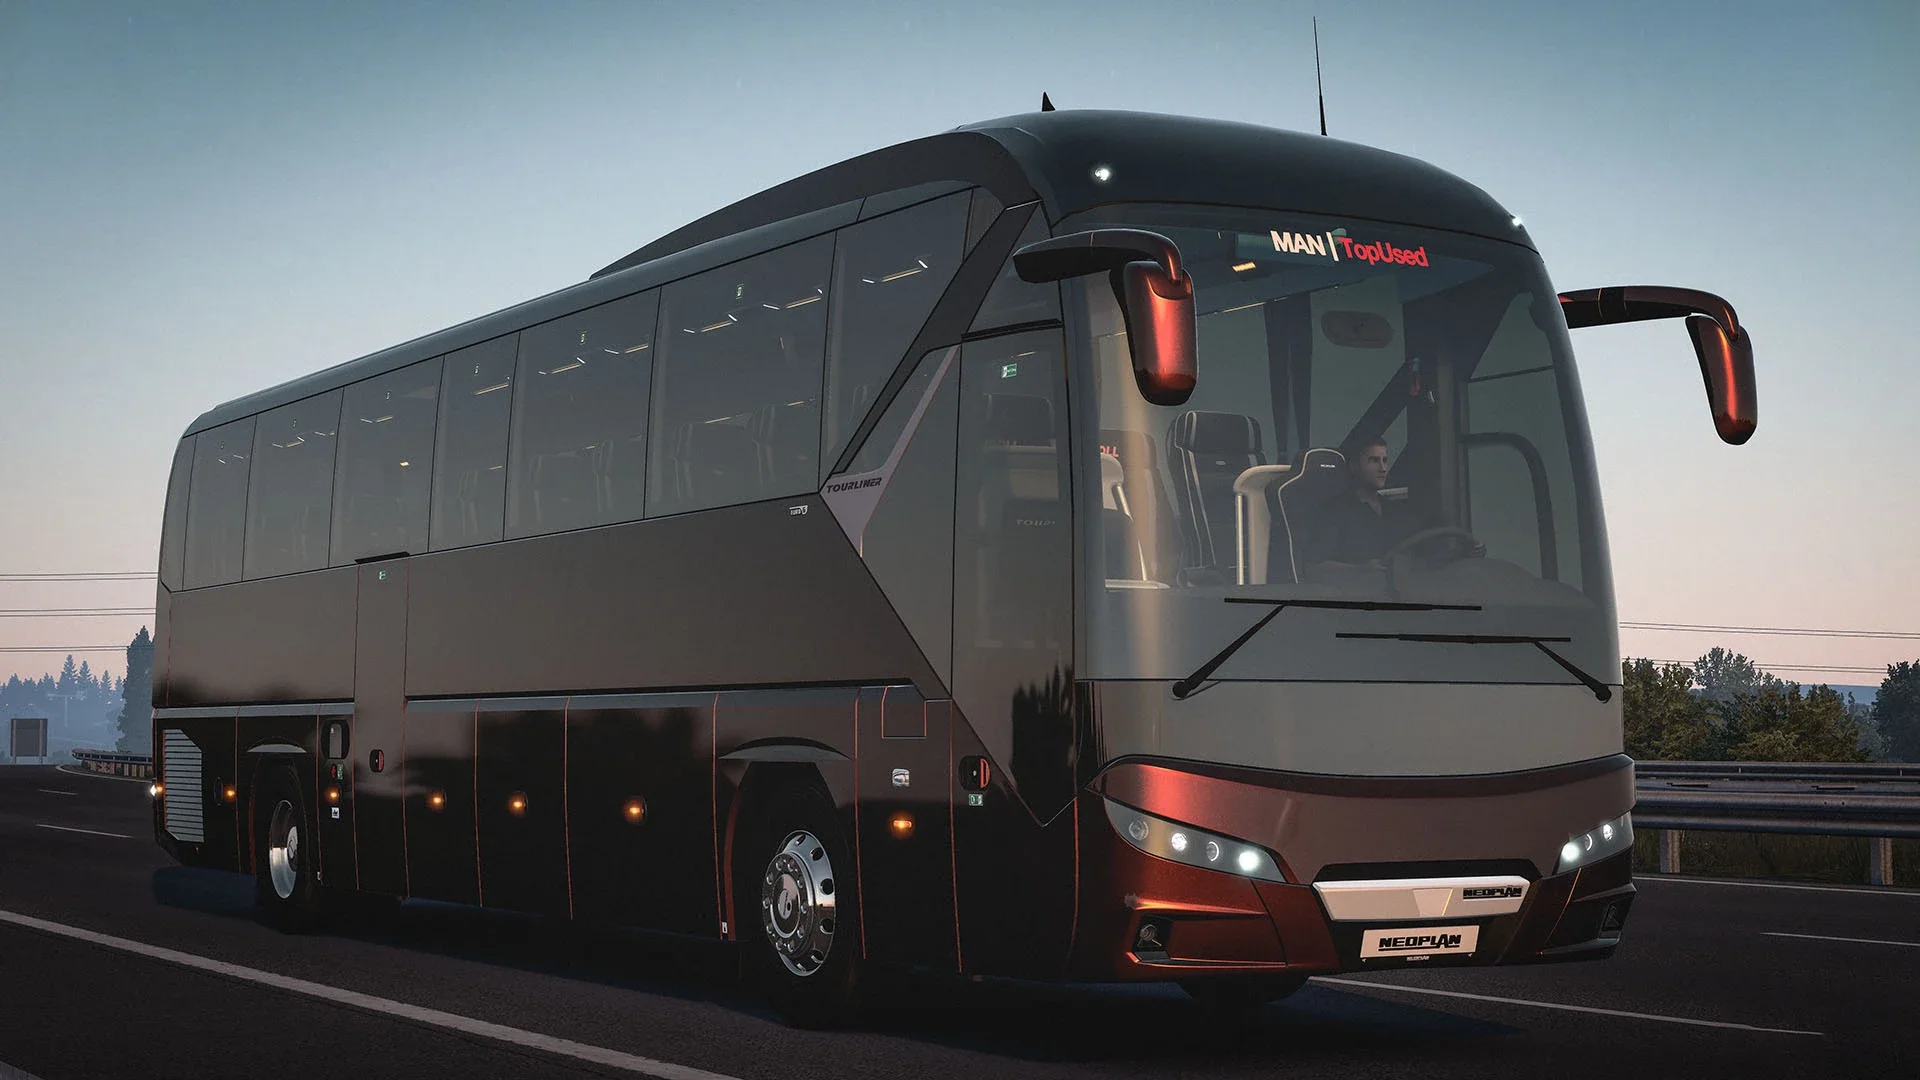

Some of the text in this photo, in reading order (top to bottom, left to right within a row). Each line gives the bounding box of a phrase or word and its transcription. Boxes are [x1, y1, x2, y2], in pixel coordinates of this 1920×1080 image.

[1270, 230, 1429, 267] MAN TopUsed
[826, 477, 882, 494] TOURLINER
[1463, 886, 1523, 899] NEOPLAN
[1378, 934, 1462, 951] NEOPLAN
